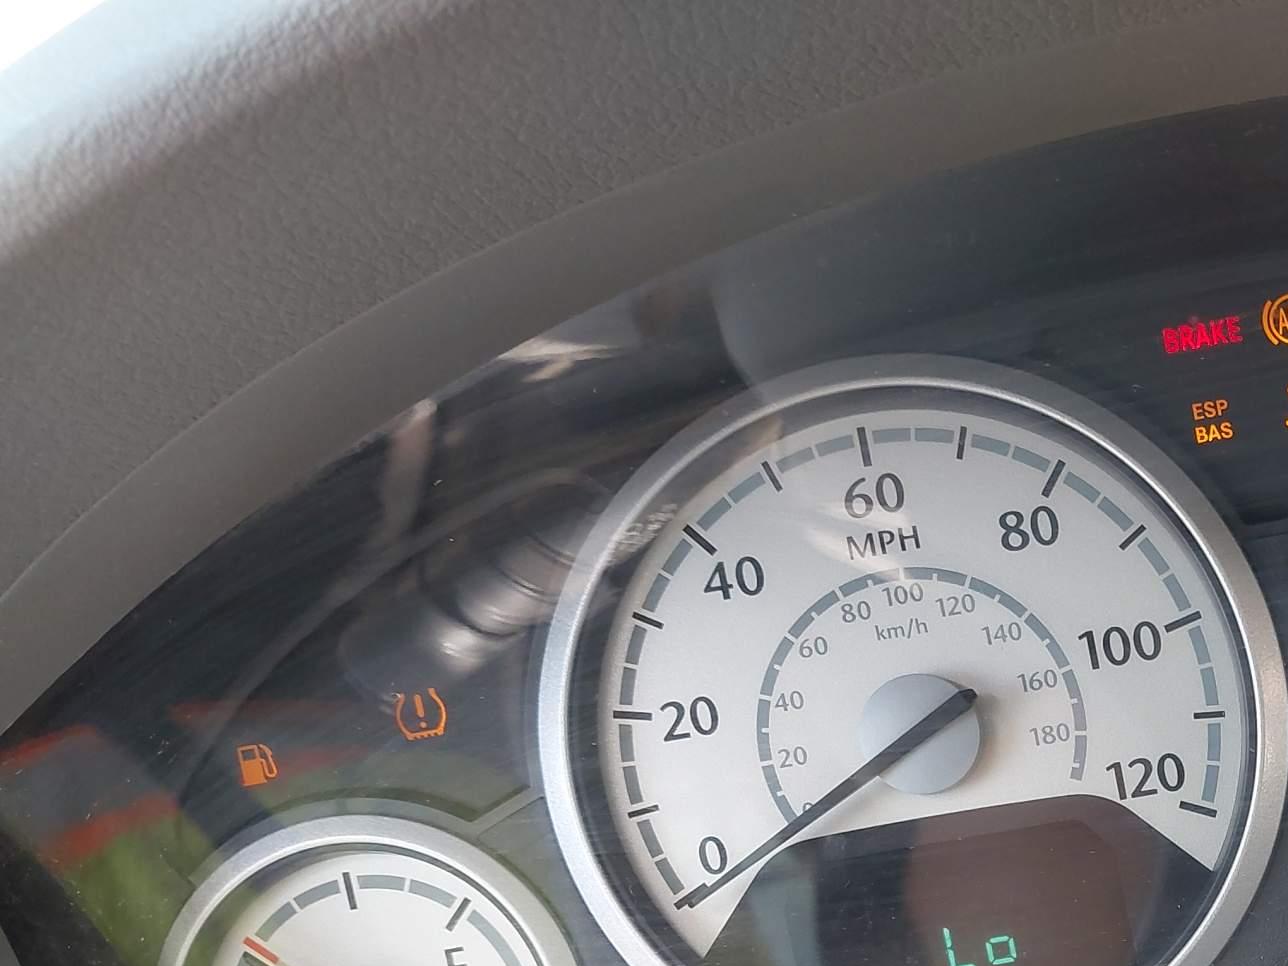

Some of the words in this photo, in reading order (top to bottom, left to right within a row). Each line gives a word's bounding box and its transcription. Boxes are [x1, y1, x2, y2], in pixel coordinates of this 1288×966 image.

[1162, 316, 1243, 354] BRAKE
[1192, 399, 1228, 420] ESP
[1195, 422, 1233, 444] BAS
[844, 472, 905, 519] 60
[998, 505, 1059, 551] 80
[846, 525, 921, 560] MPH
[704, 556, 765, 600] 40
[882, 582, 923, 607] 100
[936, 594, 976, 617] 120
[841, 601, 871, 623] 80
[874, 618, 929, 641] km/h
[981, 622, 1022, 645] 140
[799, 636, 828, 658] 60
[1078, 621, 1162, 670] 100
[1016, 669, 1057, 693] 160
[774, 691, 804, 712] 40
[660, 696, 718, 742] 20
[1029, 723, 1070, 746] 180
[778, 746, 808, 769] 20
[1106, 752, 1185, 801] 120
[698, 836, 728, 875] 0
